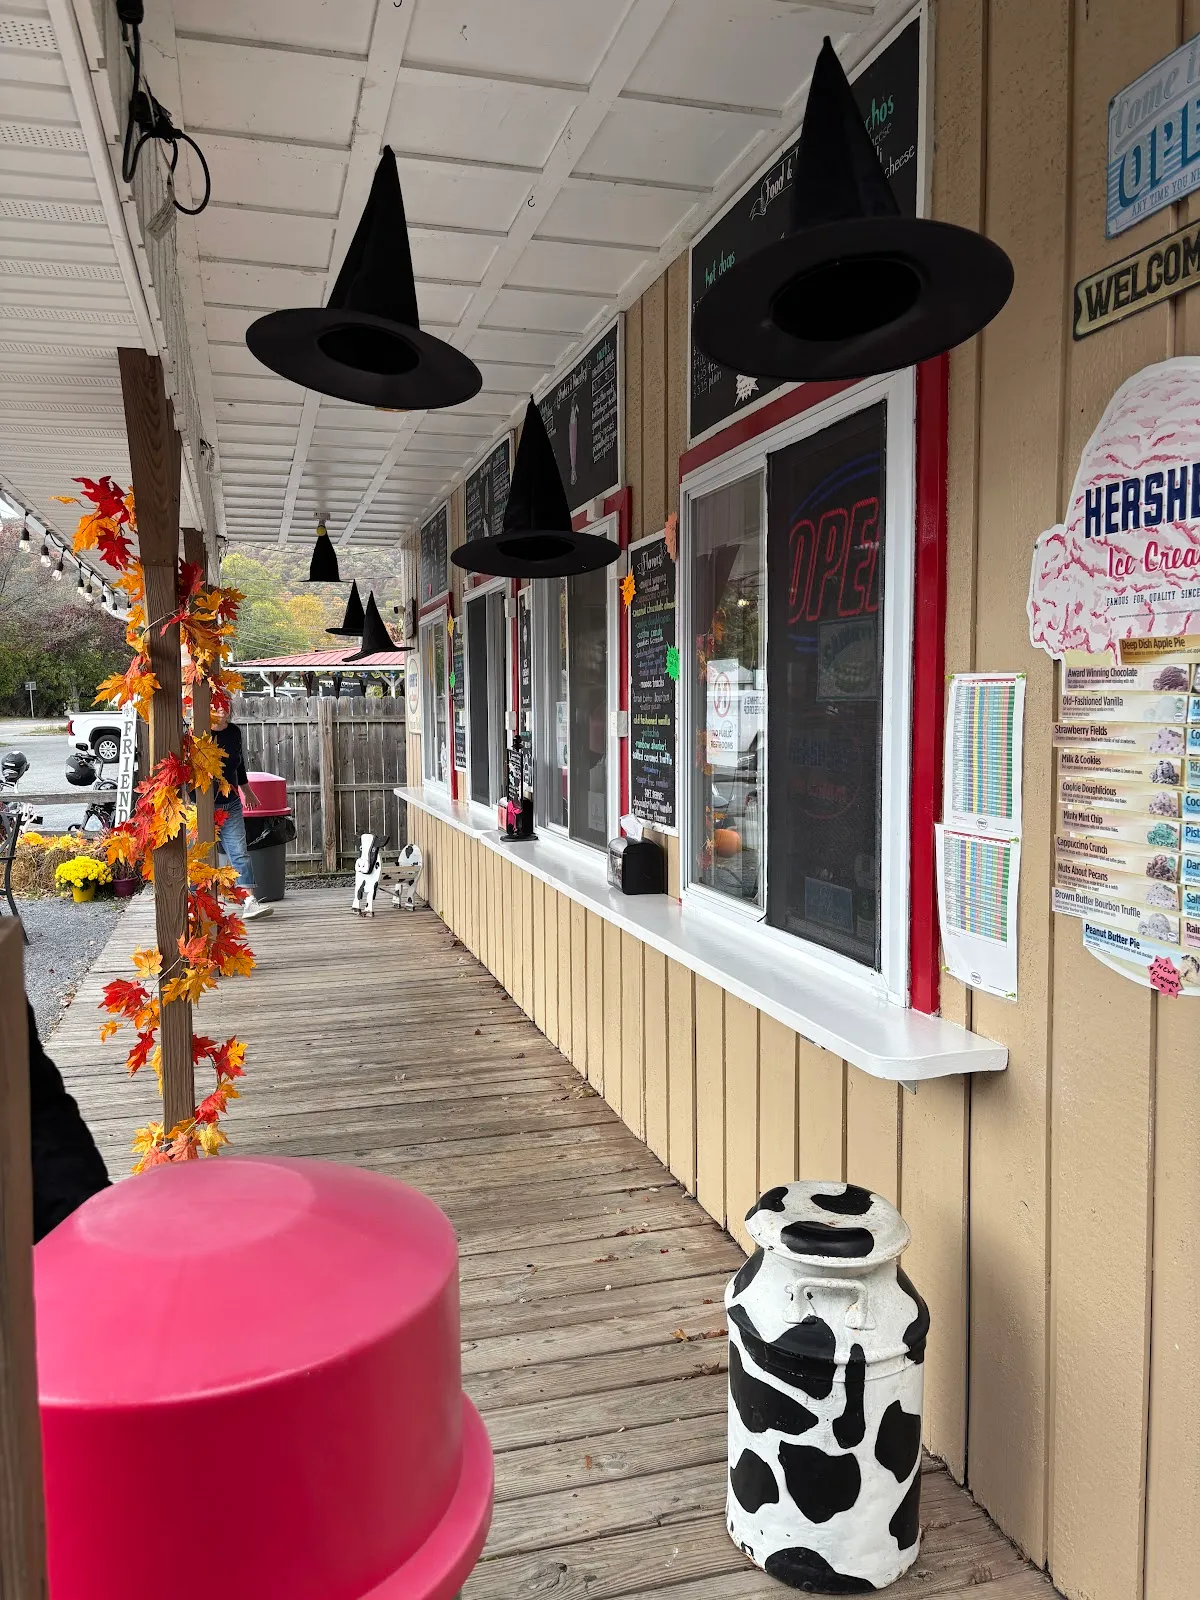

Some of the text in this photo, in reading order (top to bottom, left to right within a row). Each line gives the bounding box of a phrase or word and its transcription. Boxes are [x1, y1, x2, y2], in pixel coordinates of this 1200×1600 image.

[765, 162, 785, 203] Food
[1132, 199, 1147, 217] ANY
[1149, 186, 1169, 205] TIME
[1172, 174, 1188, 194] YOU
[1107, 546, 1136, 578] Ice
[1106, 588, 1200, 607] FAMOUS FOR QUALITY SINCE
[1122, 637, 1186, 651] Deep Dish Apple Pie
[1067, 668, 1138, 679] Award Winning Chocolate
[1104, 696, 1124, 706] Vanilla
[719, 729, 732, 738] PUBLIC
[1054, 725, 1108, 737] Strawberry Fields
[1061, 754, 1101, 765] Milk & Cookies
[119, 720, 134, 825] FRIEND
[1062, 782, 1117, 796] Cookie Doughlicious
[1063, 811, 1103, 825] Minty Mint Chip
[1057, 837, 1108, 855] Cappuccino Crunch
[1057, 863, 1108, 881] Nuts About Pecans
[1055, 889, 1075, 902] Brown
[1075, 893, 1094, 906] Butter
[1094, 897, 1120, 911] Bourbon
[1121, 904, 1141, 918] Truffle
[1085, 923, 1107, 938] Peanut
[1107, 929, 1129, 946] Butter
[1129, 937, 1141, 950] Pie
